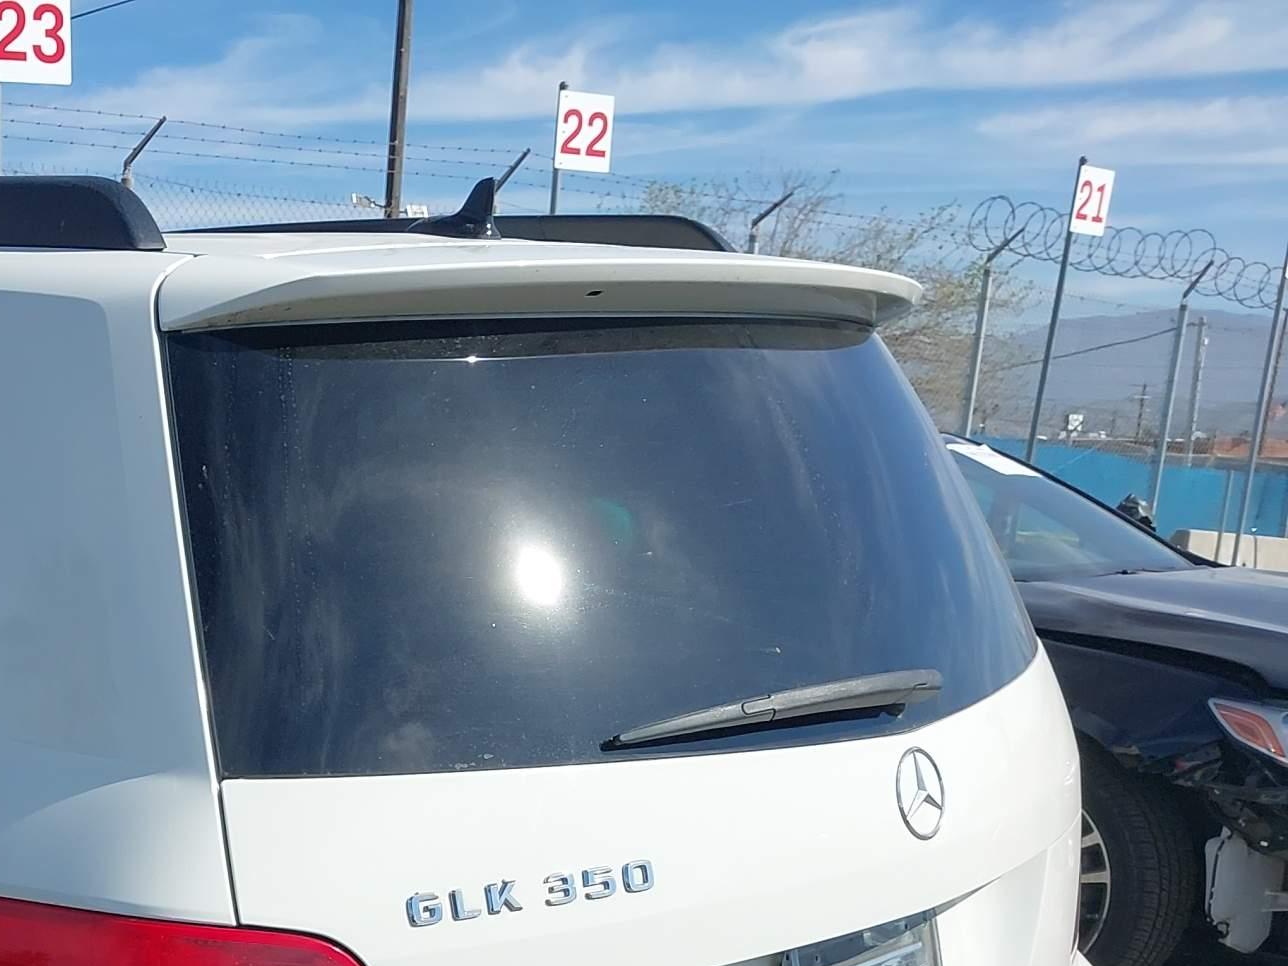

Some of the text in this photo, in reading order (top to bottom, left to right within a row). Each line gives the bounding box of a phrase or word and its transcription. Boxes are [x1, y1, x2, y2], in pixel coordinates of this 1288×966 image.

[560, 108, 608, 158] 22
[1075, 180, 1106, 223] 21
[406, 859, 655, 927] GLK 350
